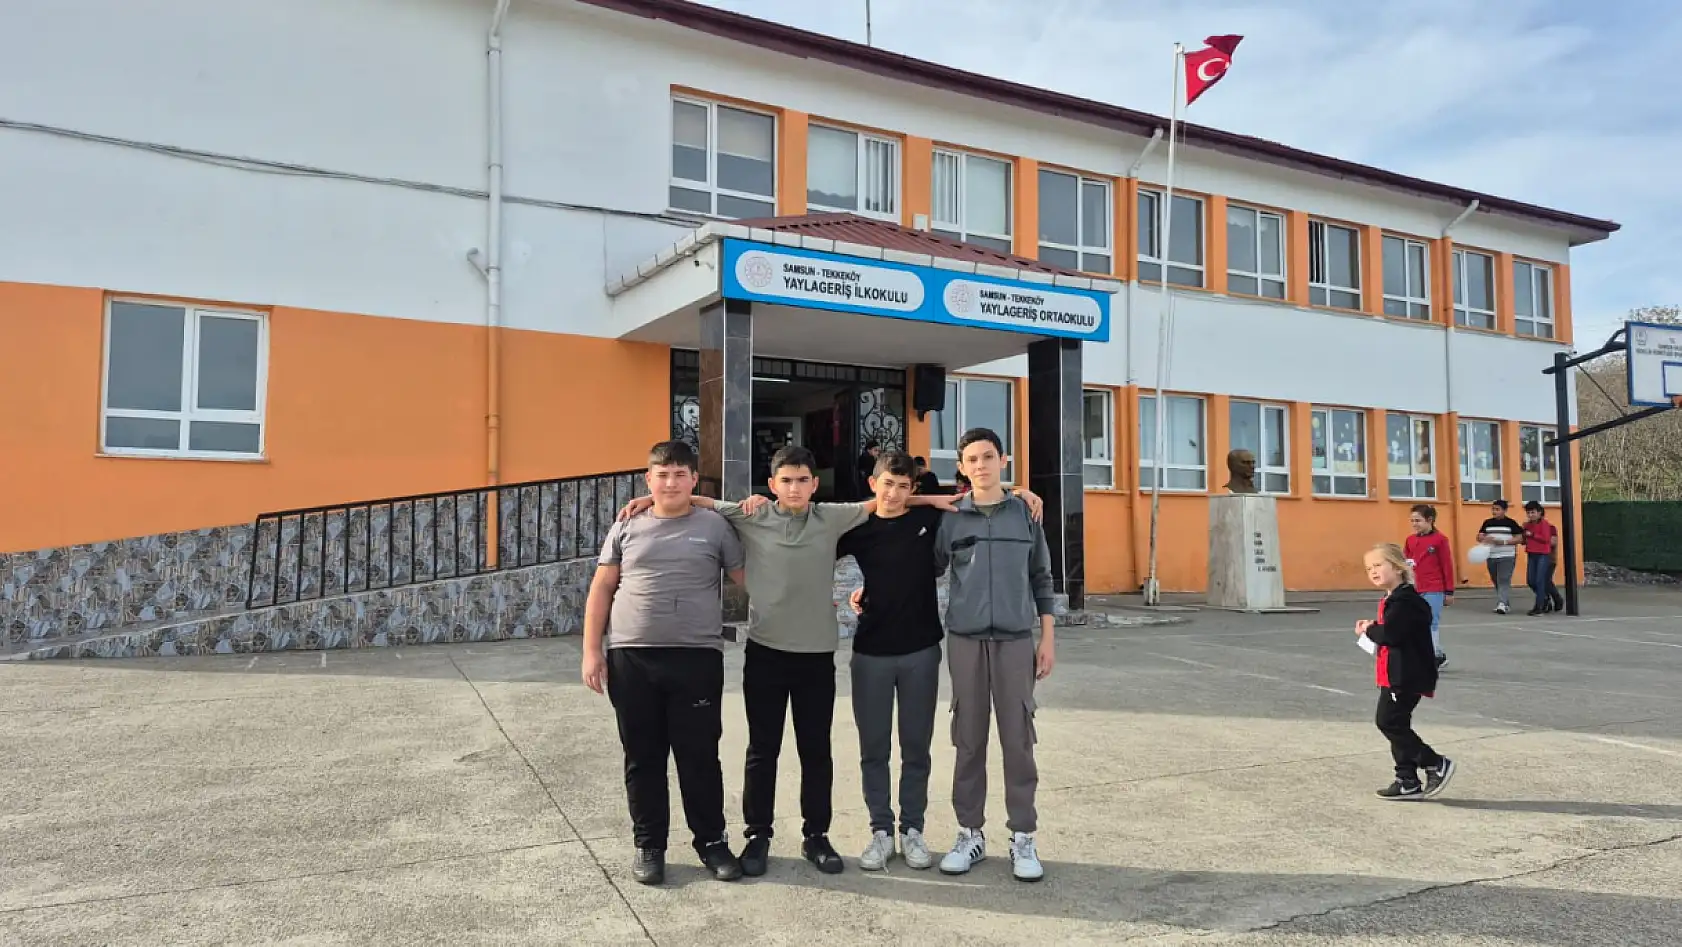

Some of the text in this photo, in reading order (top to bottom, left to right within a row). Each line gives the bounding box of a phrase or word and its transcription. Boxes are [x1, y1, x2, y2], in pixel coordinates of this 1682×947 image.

[783, 263, 815, 276] SAMSUN
[822, 268, 861, 282] TEKKEKÖY
[783, 276, 908, 303] YAYLAGERİŞ İLKOKULU
[980, 289, 1006, 301] SAMSUN
[1012, 293, 1044, 306] TEKKEKÖY
[980, 302, 1094, 327] YAYLAGERİŞ ORTAOKULU
